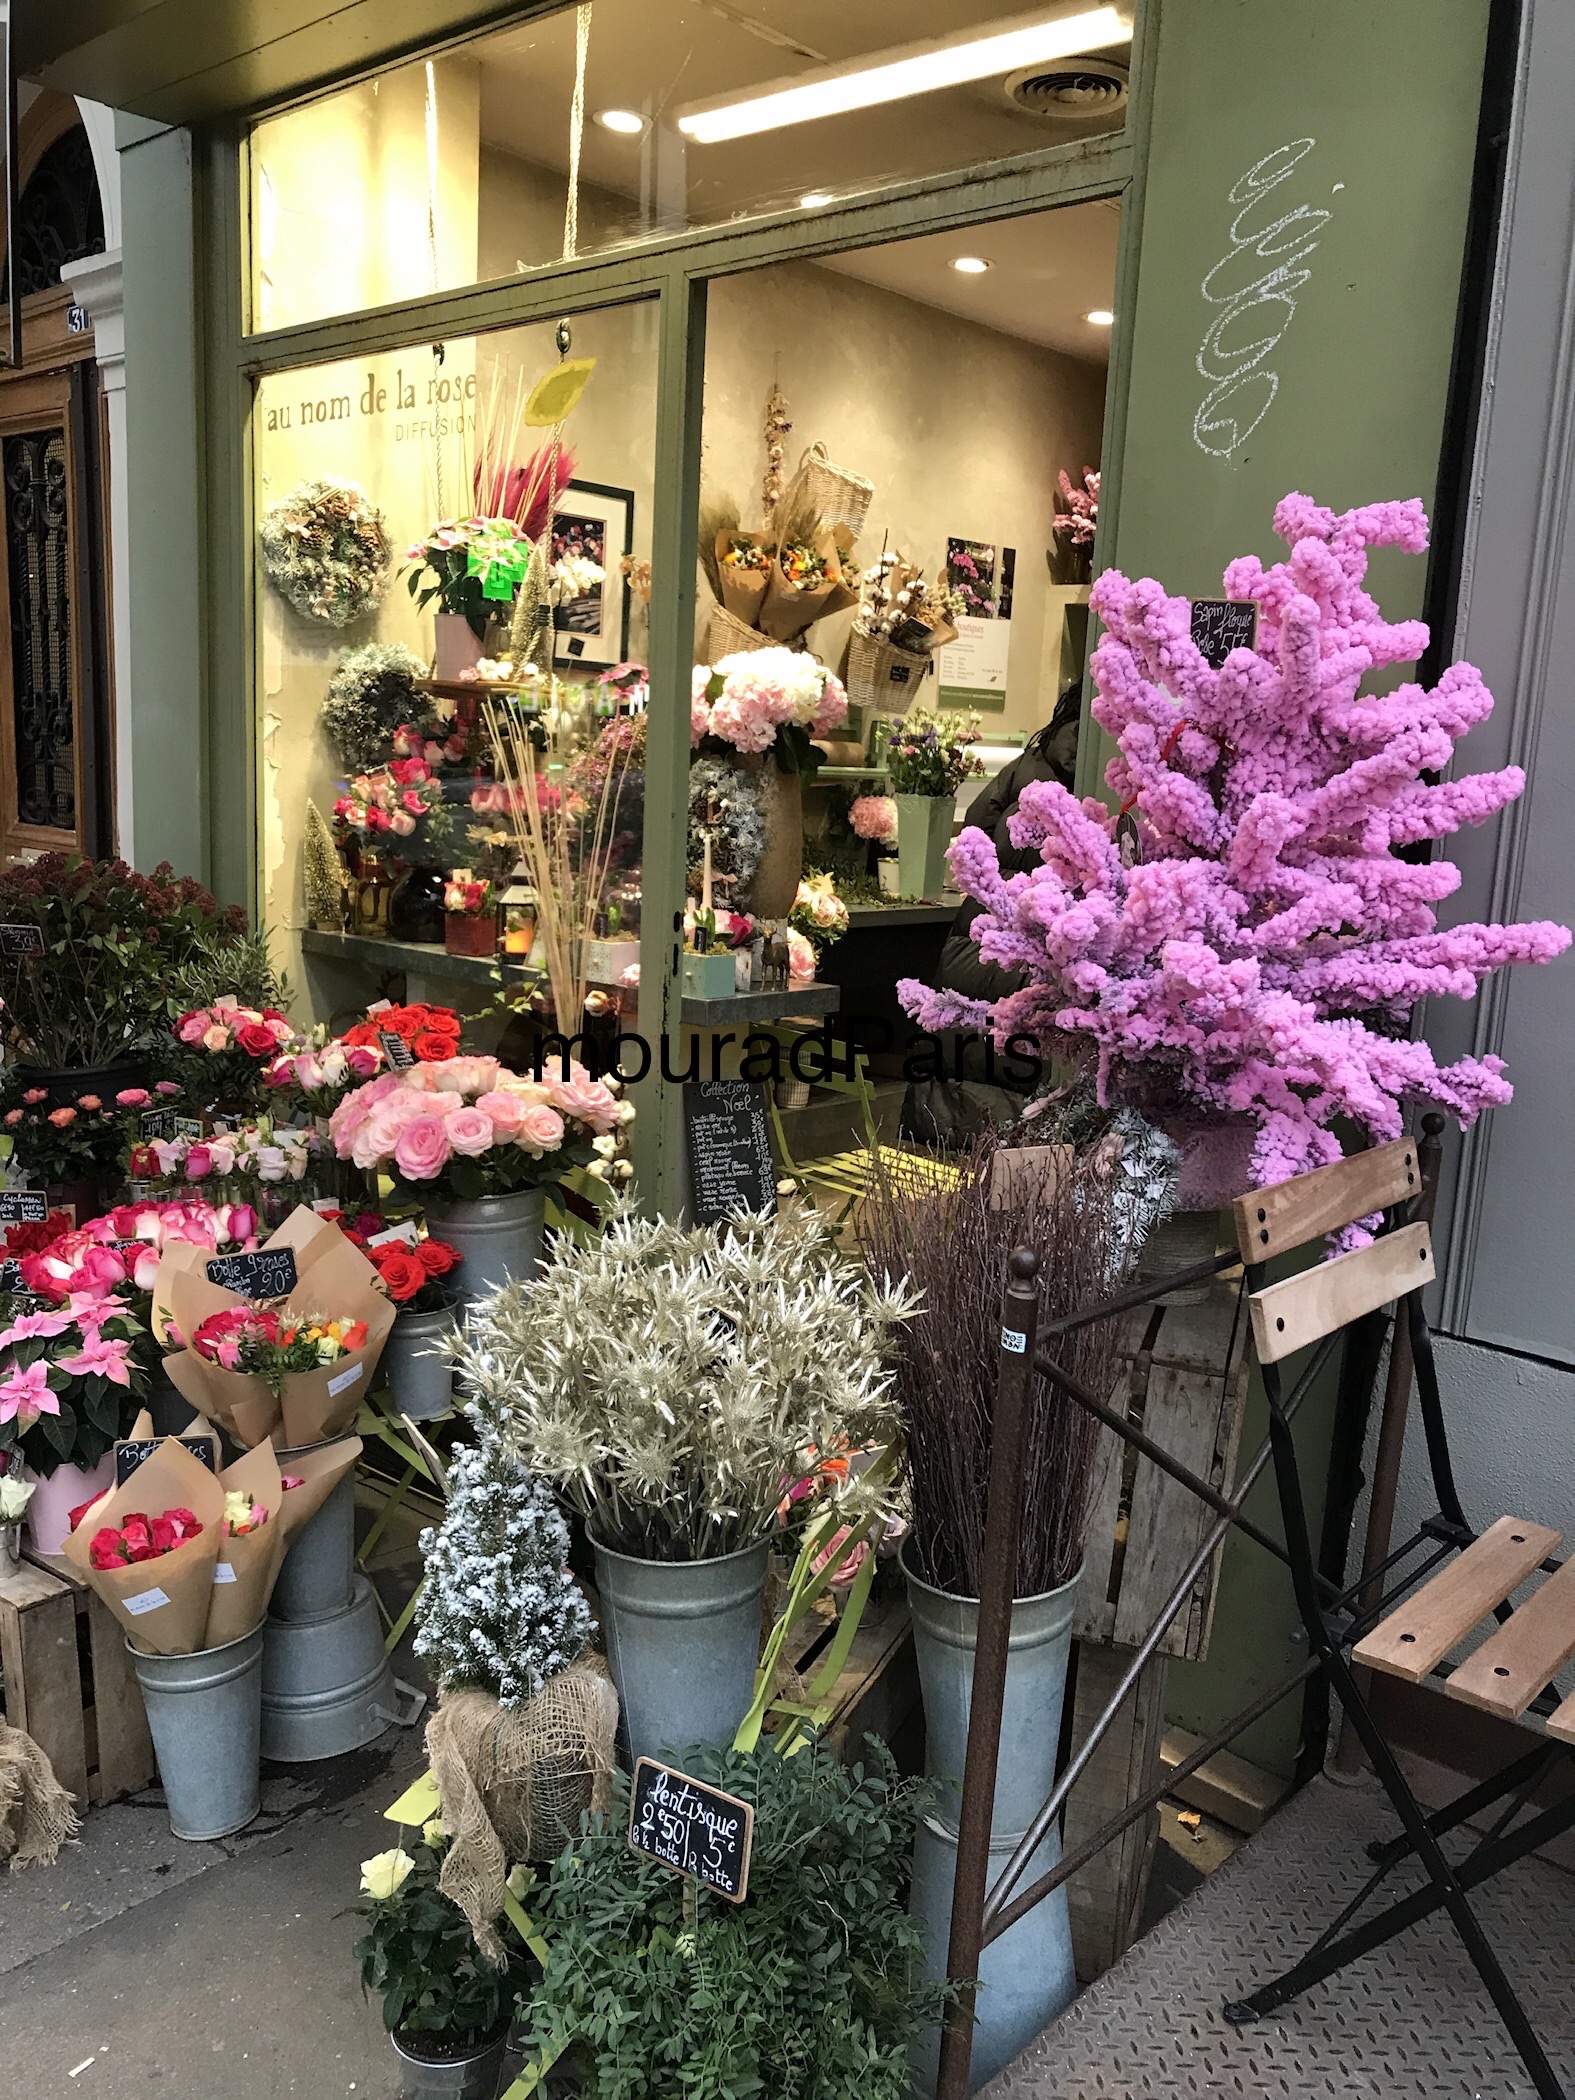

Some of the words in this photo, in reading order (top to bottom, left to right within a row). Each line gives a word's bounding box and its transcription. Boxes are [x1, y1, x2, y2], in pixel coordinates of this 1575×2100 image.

[72, 308, 85, 332] 31
[268, 407, 291, 431] au
[301, 395, 350, 425] nom
[360, 373, 387, 415] de
[397, 369, 416, 409] la
[427, 373, 477, 405] rose
[396, 415, 477, 441] DIFFUSION
[701, 1080, 749, 1098] Collection
[208, 1258, 240, 1281] Botte
[655, 1836, 680, 1866] botte
